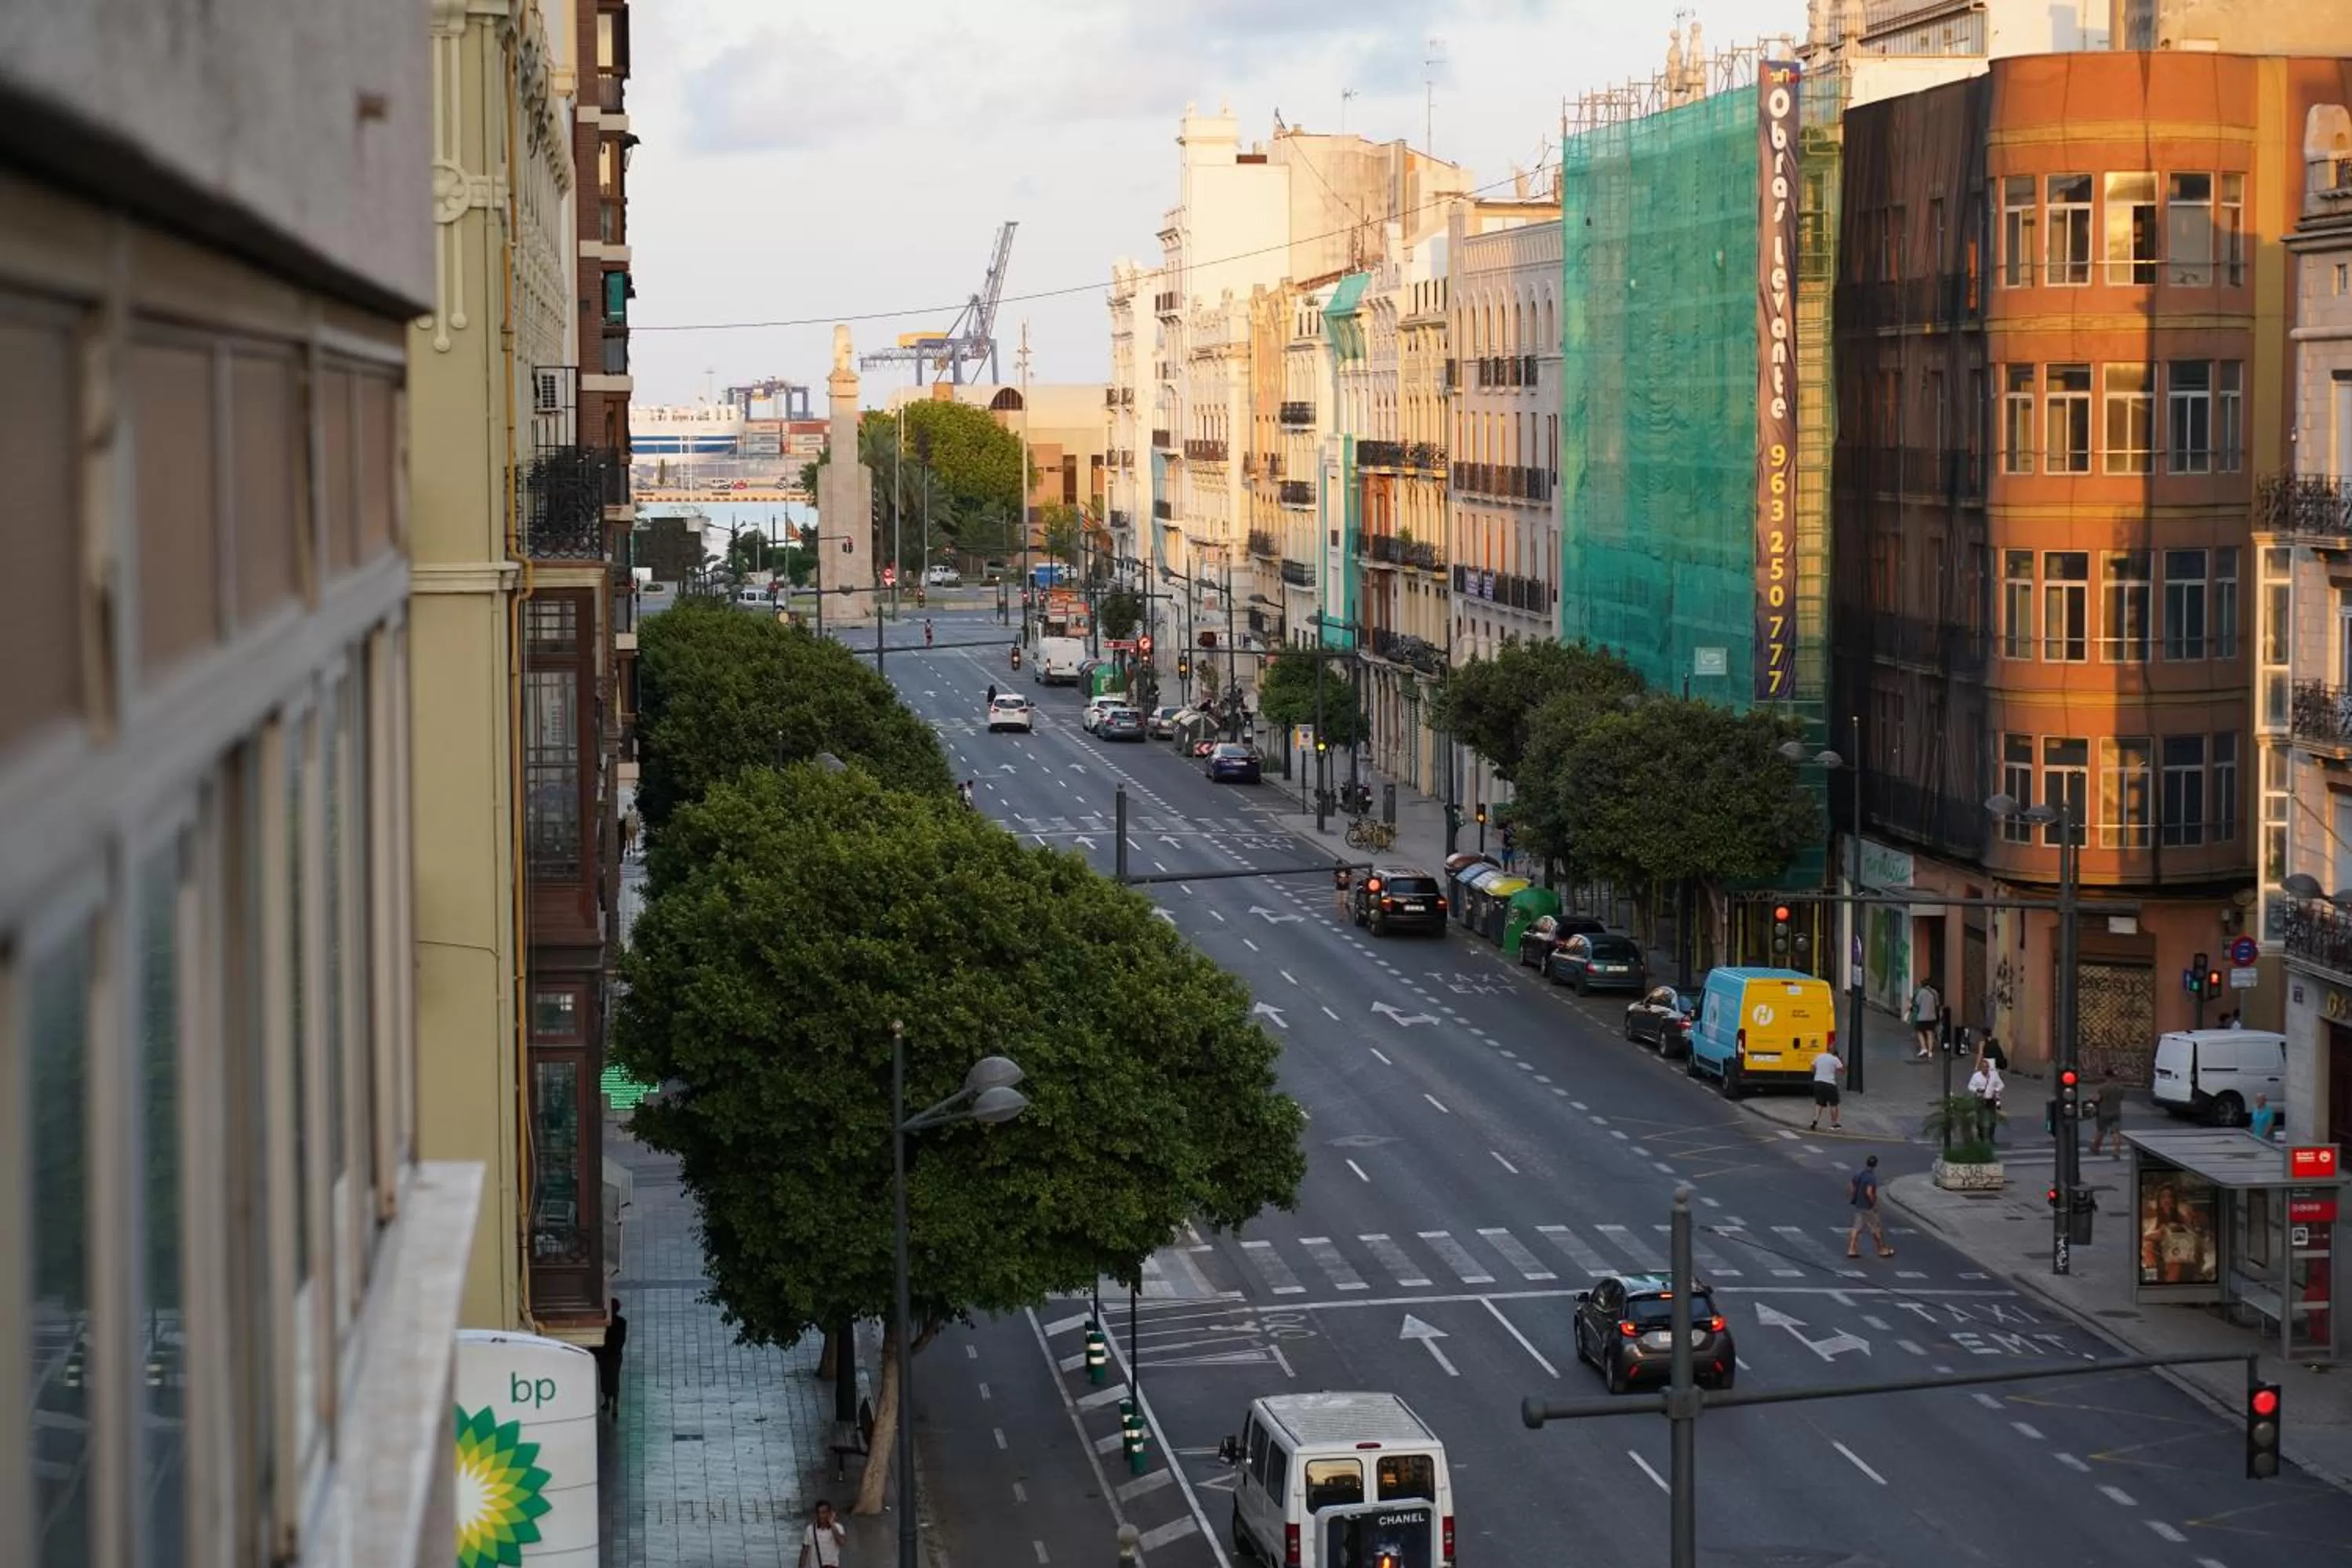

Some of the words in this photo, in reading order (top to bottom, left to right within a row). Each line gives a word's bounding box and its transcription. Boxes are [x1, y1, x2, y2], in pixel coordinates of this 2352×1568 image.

[1769, 88, 1790, 223] Obras
[1894, 1301, 2041, 1324] TAXI
[510, 1370, 556, 1410] bp
[1378, 1512, 1425, 1526] CHANEL
